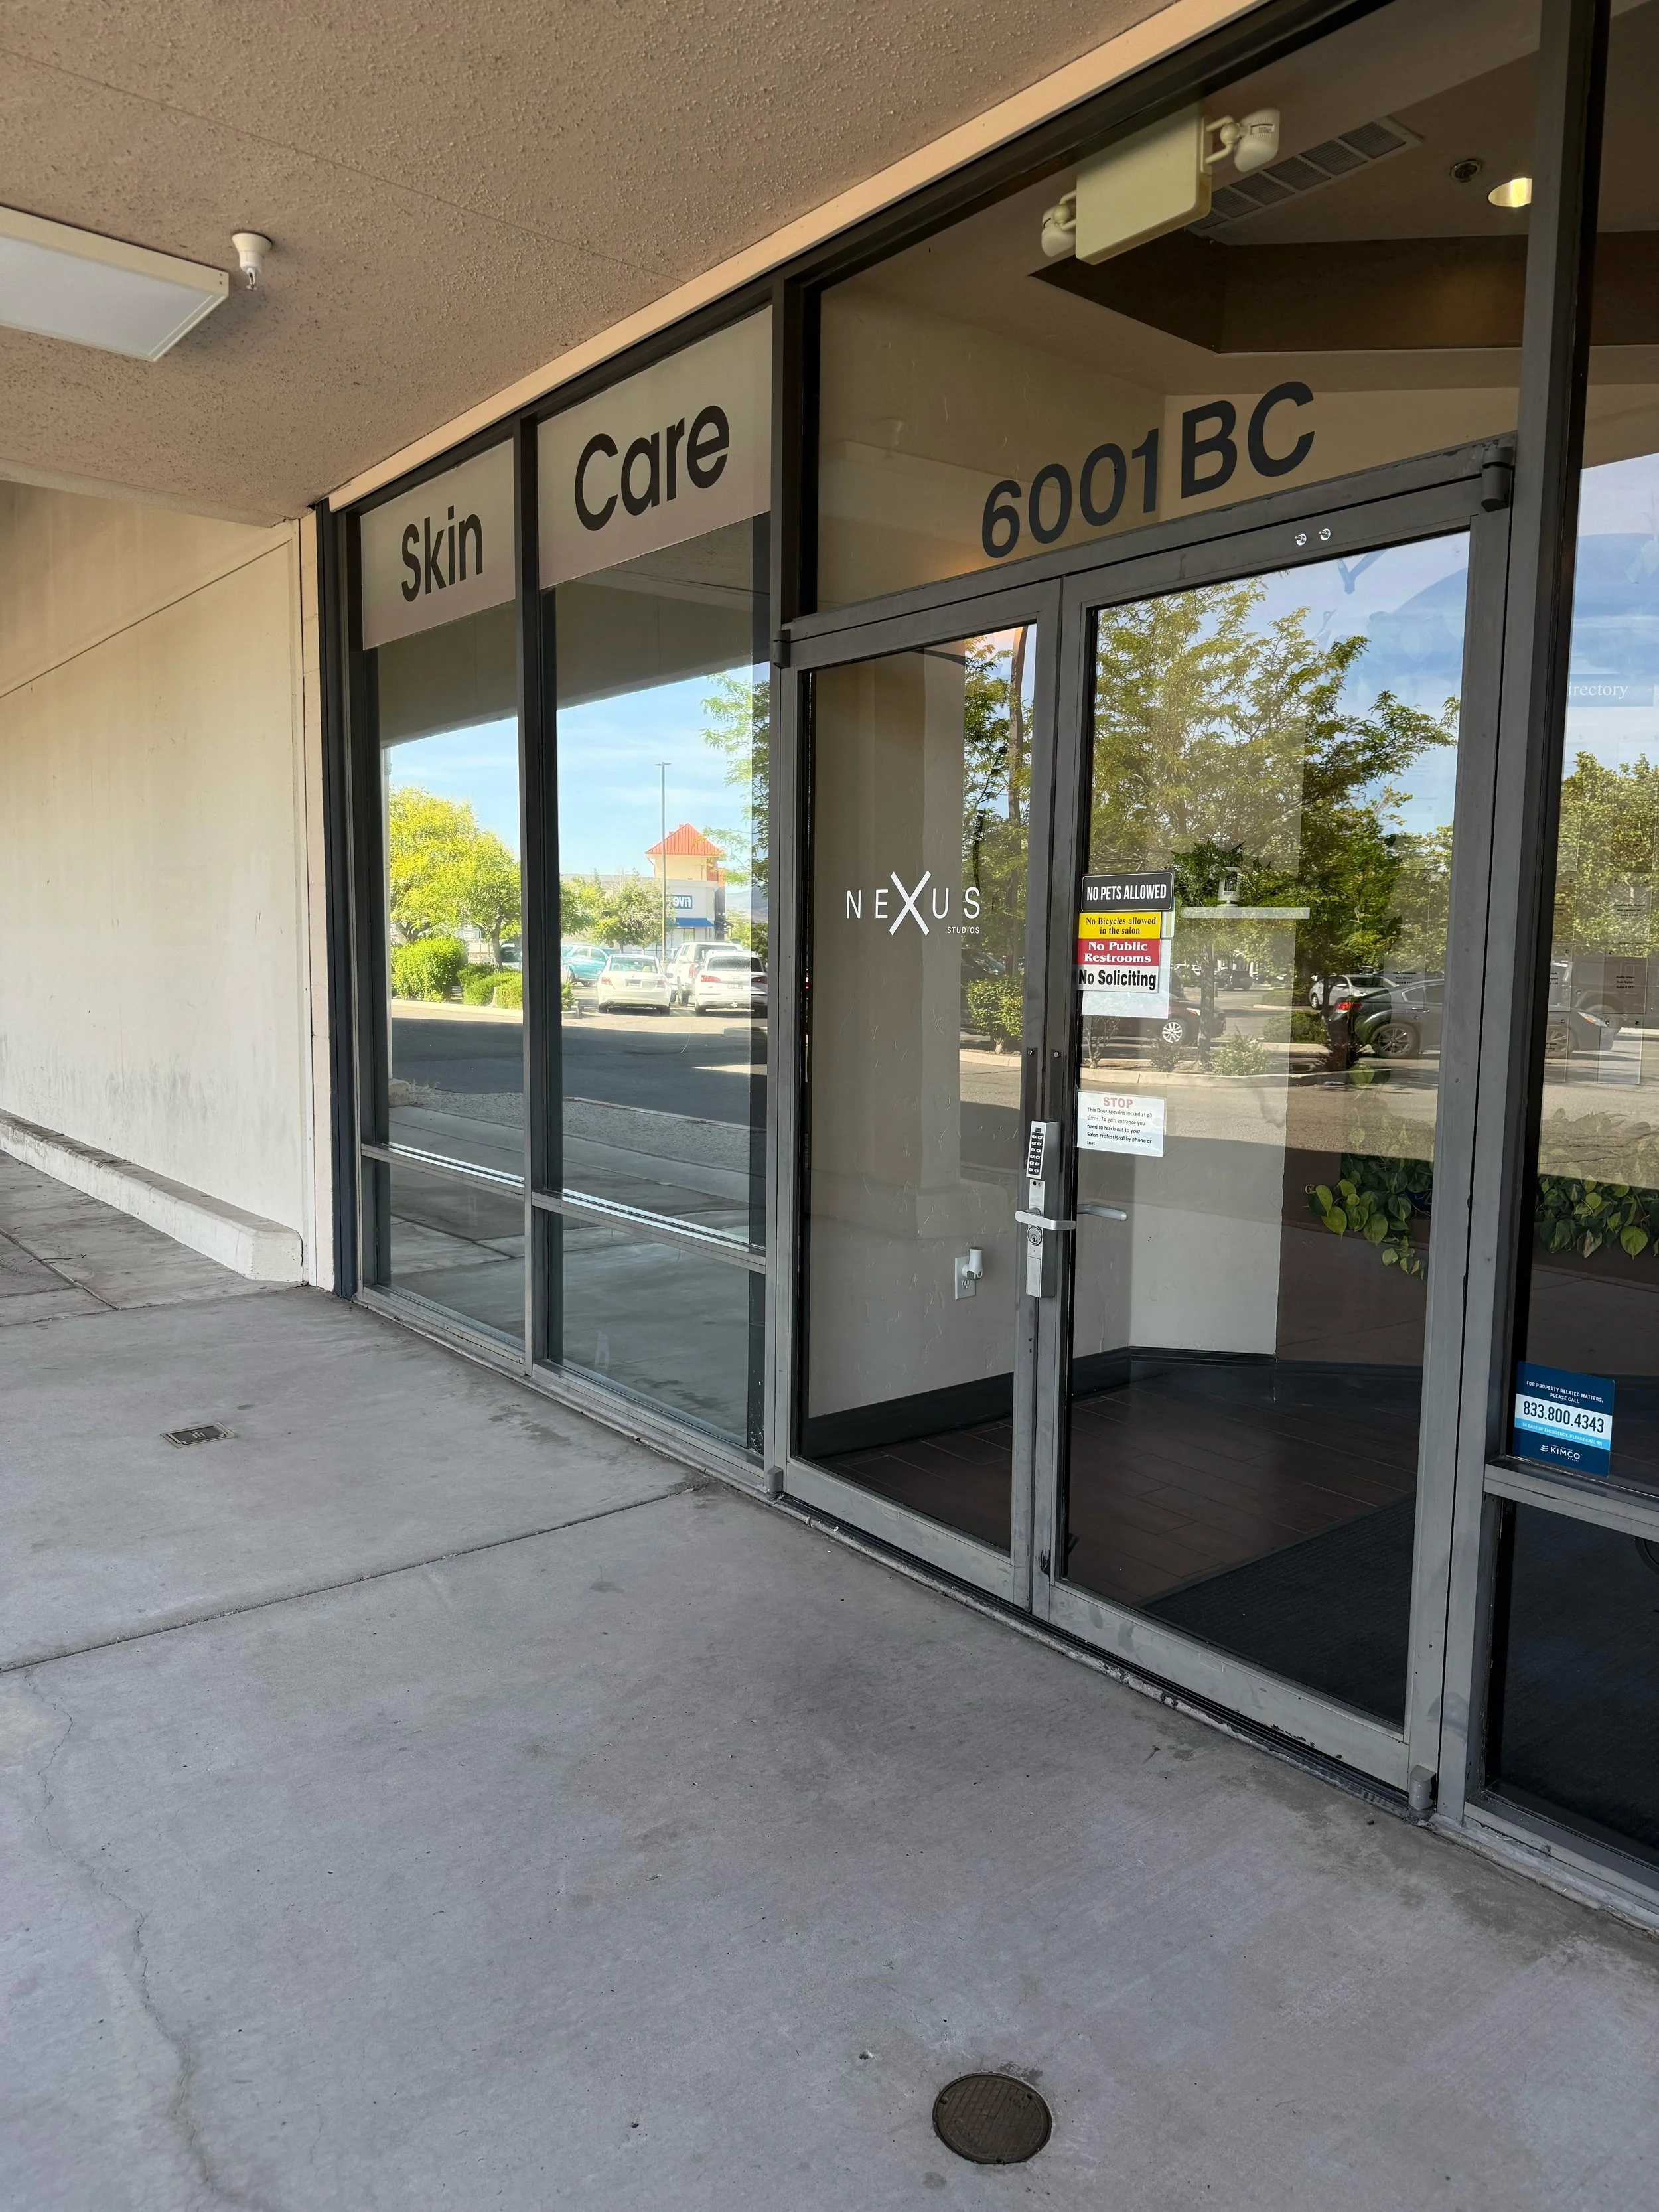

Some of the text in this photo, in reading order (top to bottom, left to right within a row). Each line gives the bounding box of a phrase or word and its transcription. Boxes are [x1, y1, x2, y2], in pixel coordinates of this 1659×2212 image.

[981, 381, 1315, 558] 6001BC
[401, 405, 730, 602] Skin Care
[1568, 682, 1628, 699] irectory
[1086, 884, 1167, 901] NO PETS ALLOWED
[846, 870, 980, 936] NEXUS
[1098, 917, 1126, 926] Bicycles
[1088, 942, 1148, 951] No Public
[1084, 953, 1151, 963] Restrooms
[1078, 970, 1156, 990] No Soliciting
[1103, 1096, 1133, 1108] STOP
[1100, 1132, 1125, 1141] Professional
[1536, 1382, 1559, 1392] PROPERTY
[1560, 1388, 1580, 1397] RELATED
[1581, 1394, 1603, 1403] MATTERS,
[1523, 1400, 1604, 1433] 833.800.4343
[1550, 1446, 1580, 1460] KIMCO
